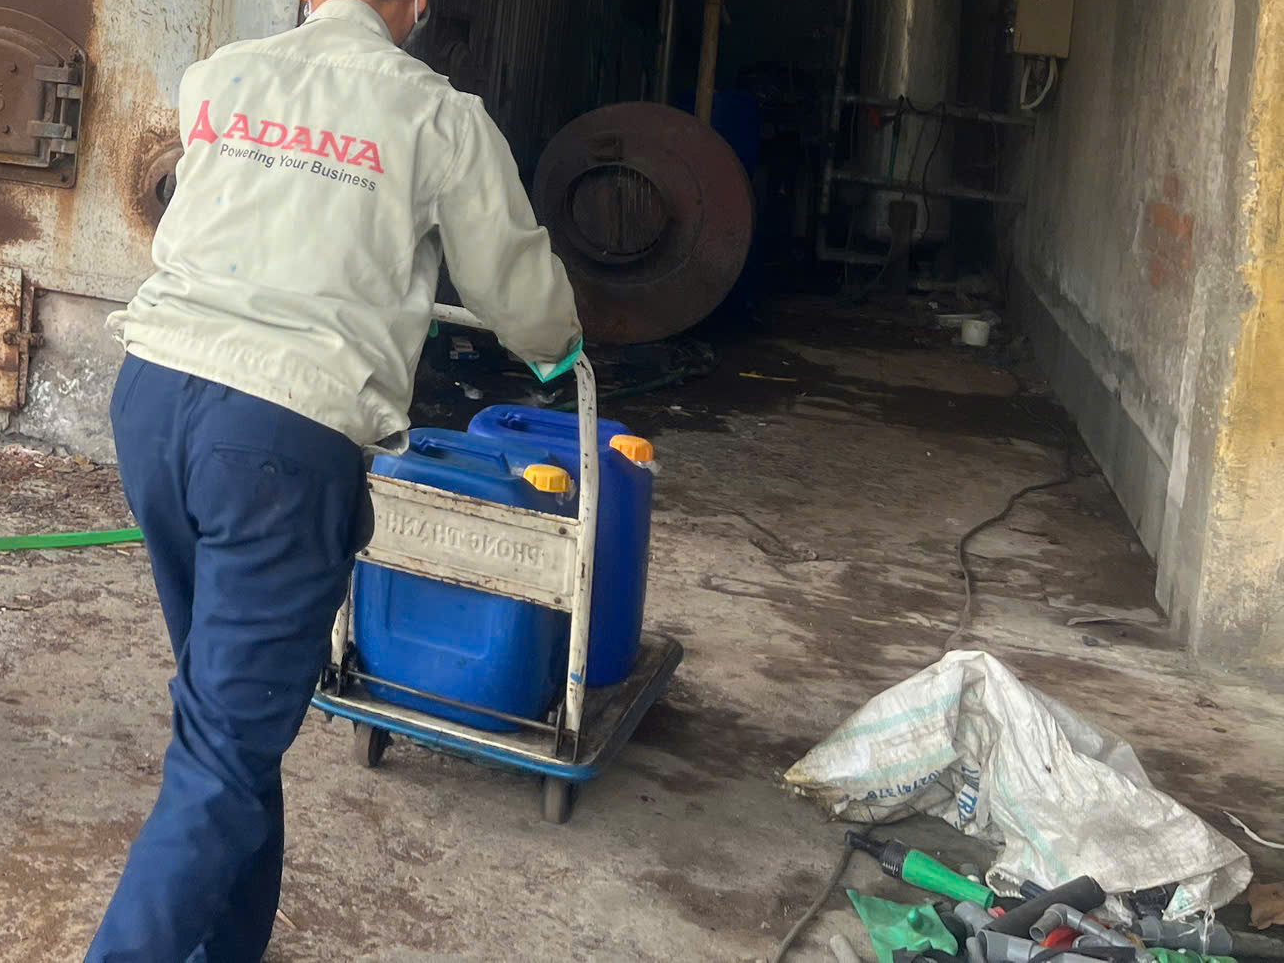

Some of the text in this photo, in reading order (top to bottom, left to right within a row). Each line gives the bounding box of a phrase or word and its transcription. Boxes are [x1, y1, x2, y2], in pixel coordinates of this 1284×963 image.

[219, 143, 377, 192] Powering Your Business
[222, 112, 385, 174] ADANA
